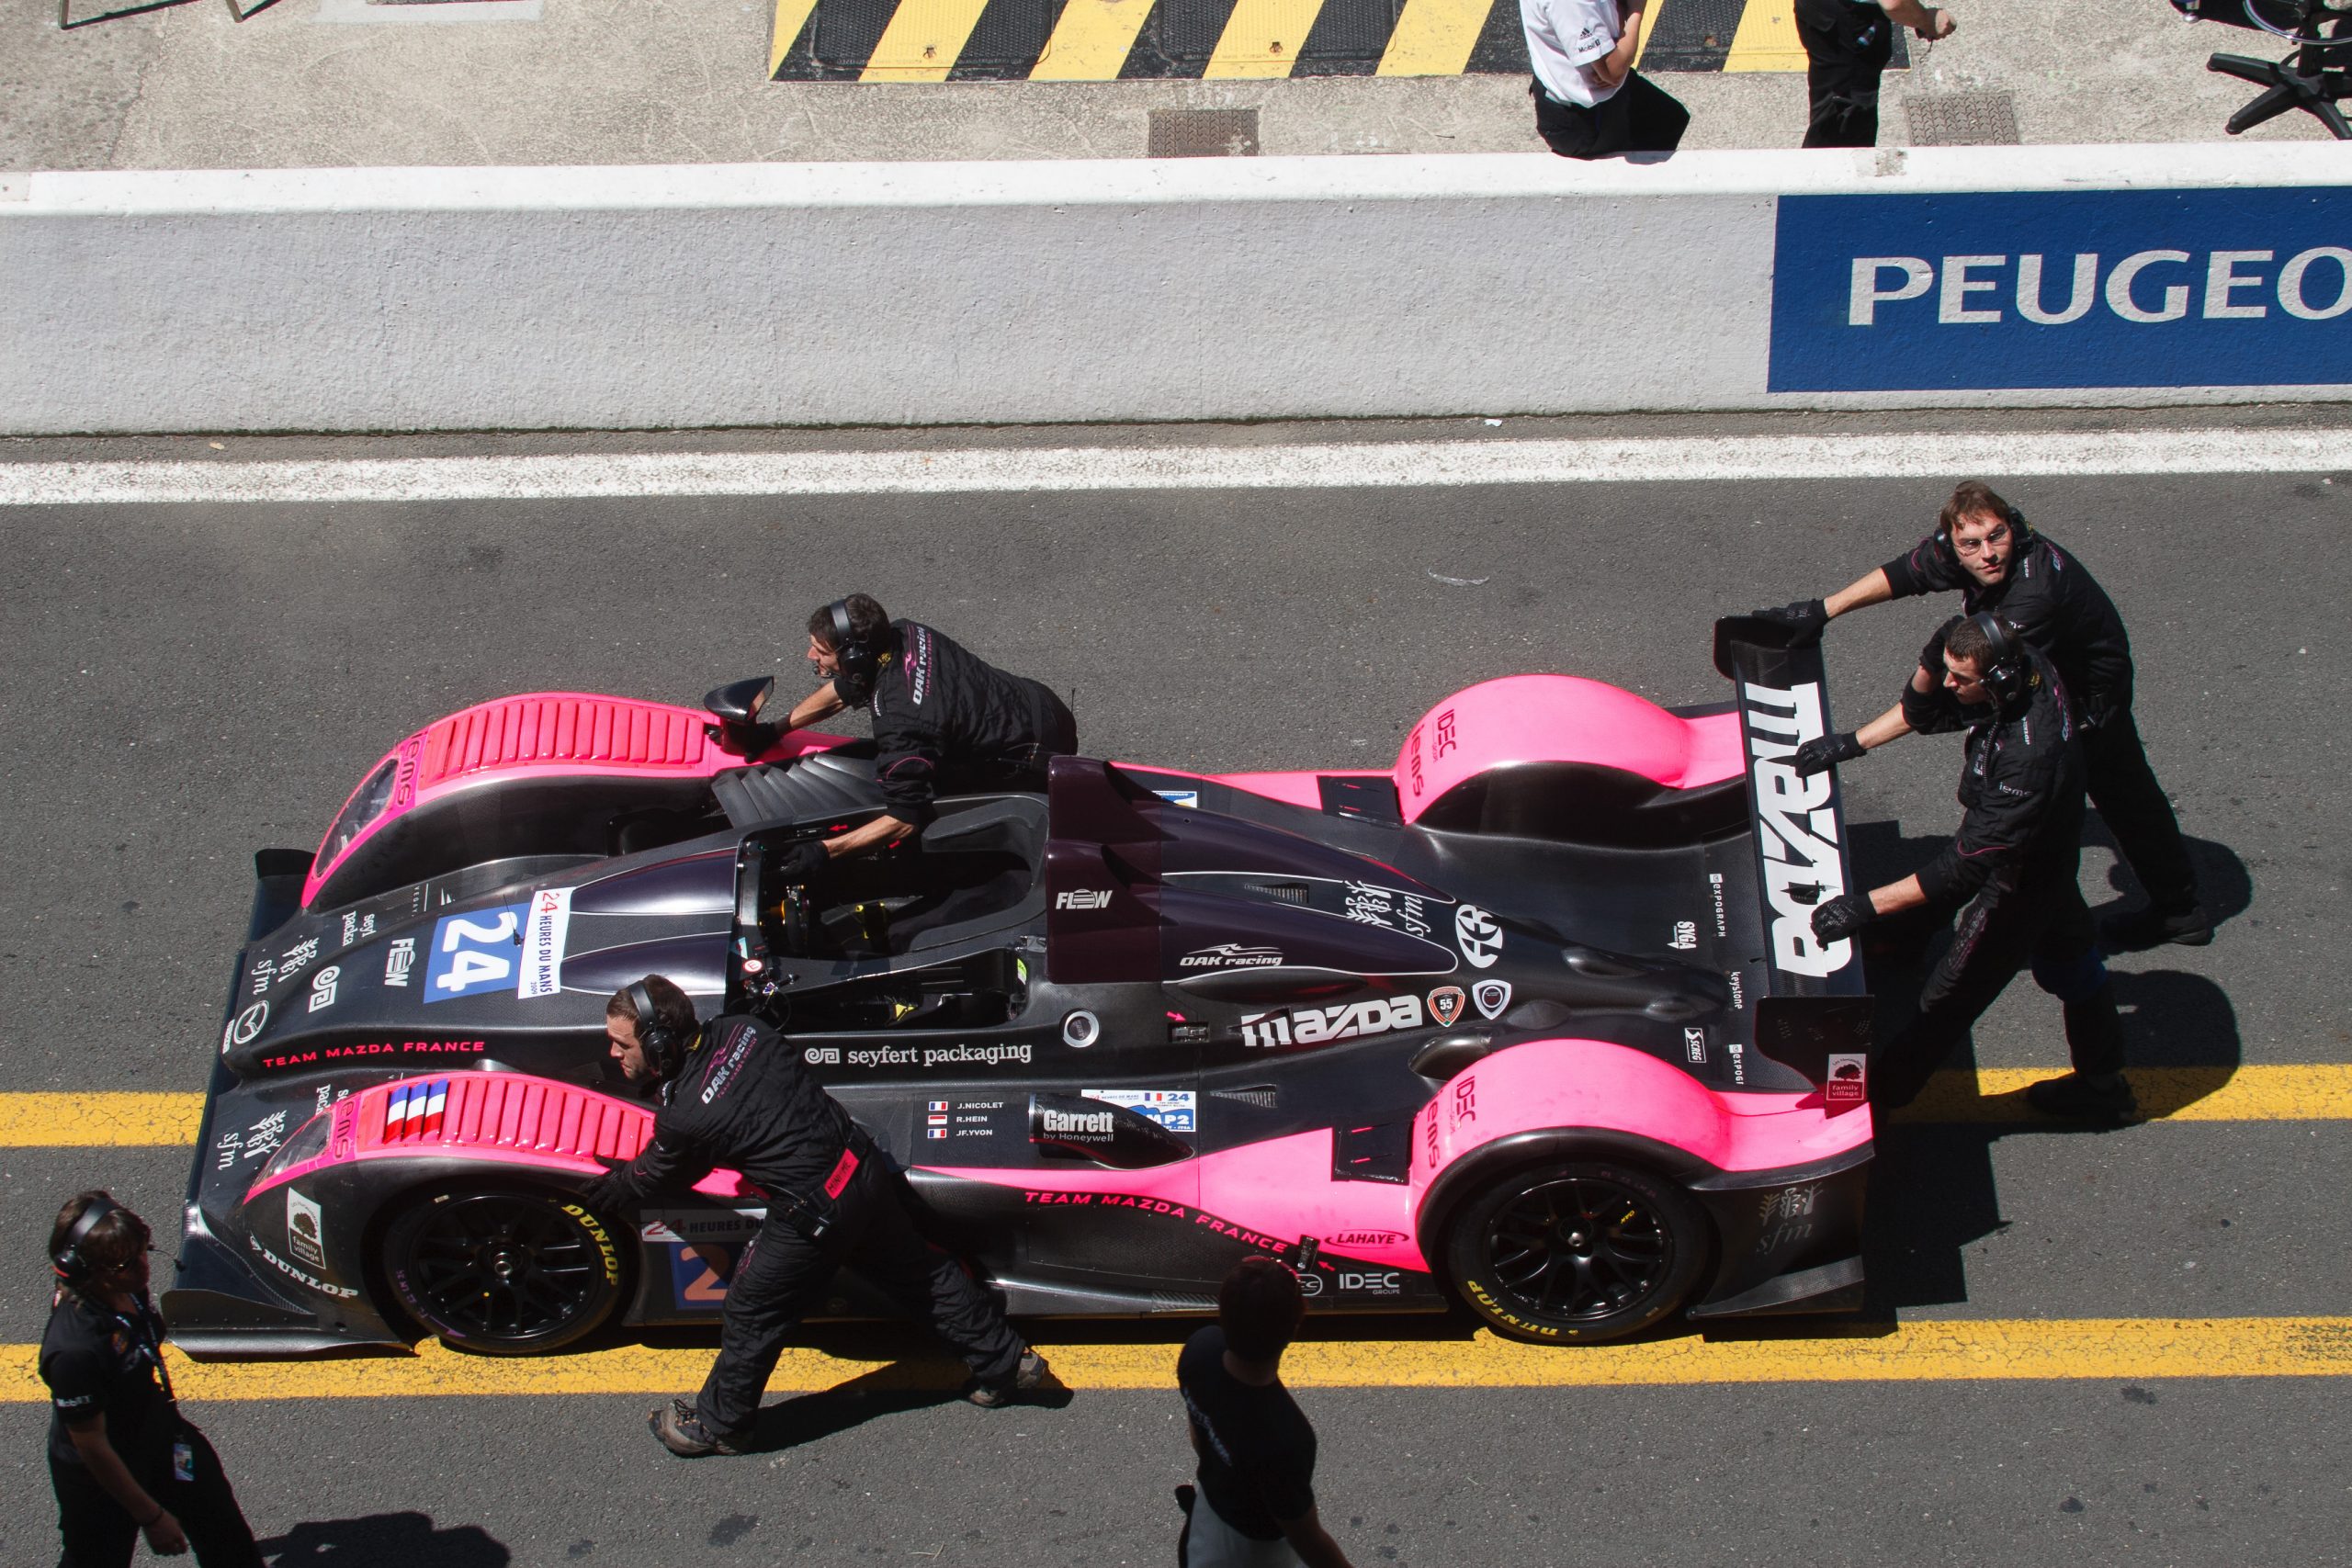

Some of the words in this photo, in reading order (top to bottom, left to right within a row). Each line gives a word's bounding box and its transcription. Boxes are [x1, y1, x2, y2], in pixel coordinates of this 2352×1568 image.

[1849, 246, 2352, 326] PEUGEO
[917, 626, 927, 666] racin
[912, 666, 926, 705] OAK
[1438, 708, 1457, 759] IDEC
[540, 892, 562, 914] 24
[538, 915, 552, 948] HEURES
[436, 911, 519, 993] 24
[538, 949, 552, 964] DU
[1180, 956, 1224, 966] OAK
[1225, 955, 1283, 967] racing
[251, 959, 277, 996] sfm
[538, 965, 553, 994] MANS
[1728, 971, 1743, 1010] keystone
[1440, 998, 1453, 1010] 55
[263, 1051, 318, 1067] TEAM
[326, 1043, 394, 1058] MAZDA
[403, 1041, 485, 1053] FRANCE
[701, 1066, 730, 1104] OAK
[728, 1026, 756, 1069] racing
[847, 1044, 918, 1067] seyfert
[923, 1043, 1033, 1067] packaging
[1167, 1093, 1190, 1101] 24
[1456, 1075, 1476, 1129] IDEC
[1043, 1109, 1114, 1133] Garrett
[1146, 1113, 1190, 1125] MP2
[956, 1129, 993, 1137] JF.YVON
[1044, 1133, 1057, 1141] by
[1059, 1133, 1114, 1144] Honeywell
[217, 1133, 243, 1171] sfm
[645, 1219, 686, 1236] 24
[689, 1220, 743, 1233] HEURES
[1025, 1191, 1091, 1205] TEAM
[1102, 1195, 1185, 1218] MAZDA
[1195, 1214, 1287, 1254] FRANCE
[293, 1235, 318, 1255] family
[561, 1203, 619, 1286] DUNLOP
[1337, 1233, 1396, 1245] LAHAYE
[294, 1246, 320, 1263] village
[263, 1249, 359, 1298] DUNLOP
[1339, 1272, 1400, 1290] IDEC
